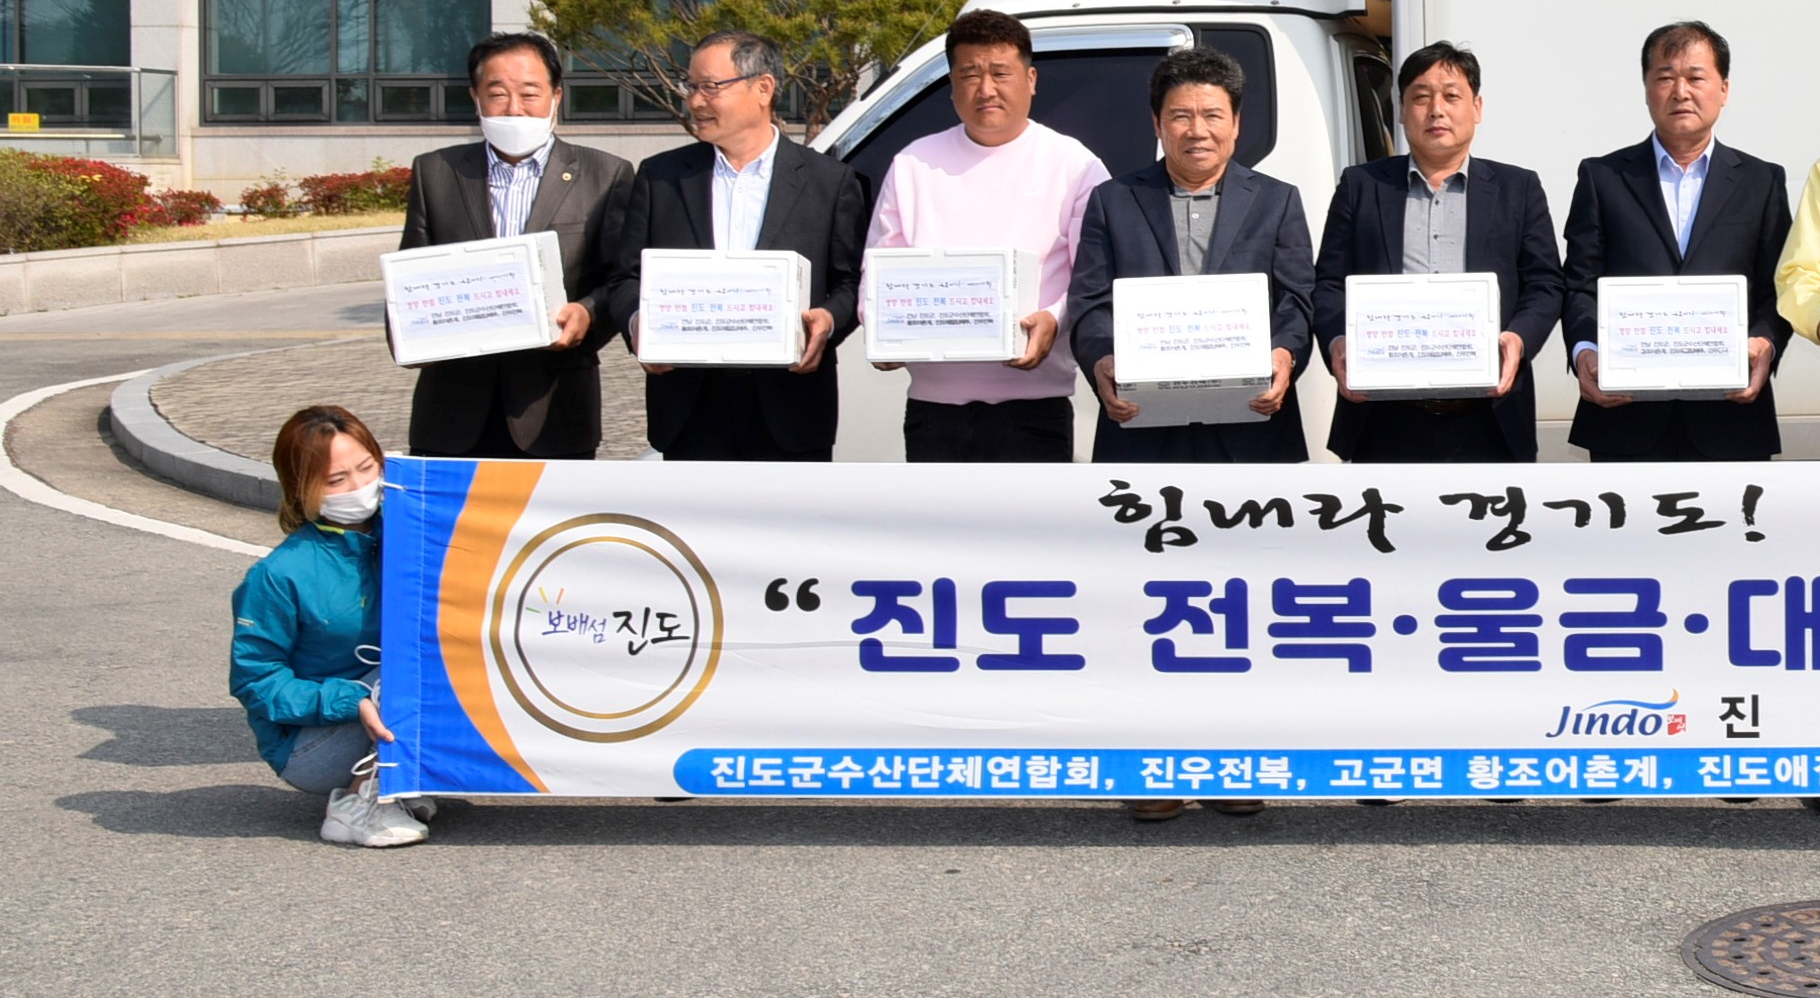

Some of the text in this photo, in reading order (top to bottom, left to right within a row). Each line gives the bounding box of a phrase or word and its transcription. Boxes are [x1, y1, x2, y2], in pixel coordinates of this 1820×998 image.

[1099, 479, 1404, 553] 힘내라
[1438, 484, 1765, 553] 경기도!
[541, 606, 690, 656] 보배섬 진도
[1545, 705, 1664, 738] Jindo
[711, 754, 1114, 790] 진도군수산단체연합회,
[1140, 755, 1307, 791] 진우전복,
[1329, 755, 1444, 791] 고군면
[1467, 754, 1673, 790] 황조어촌계,
